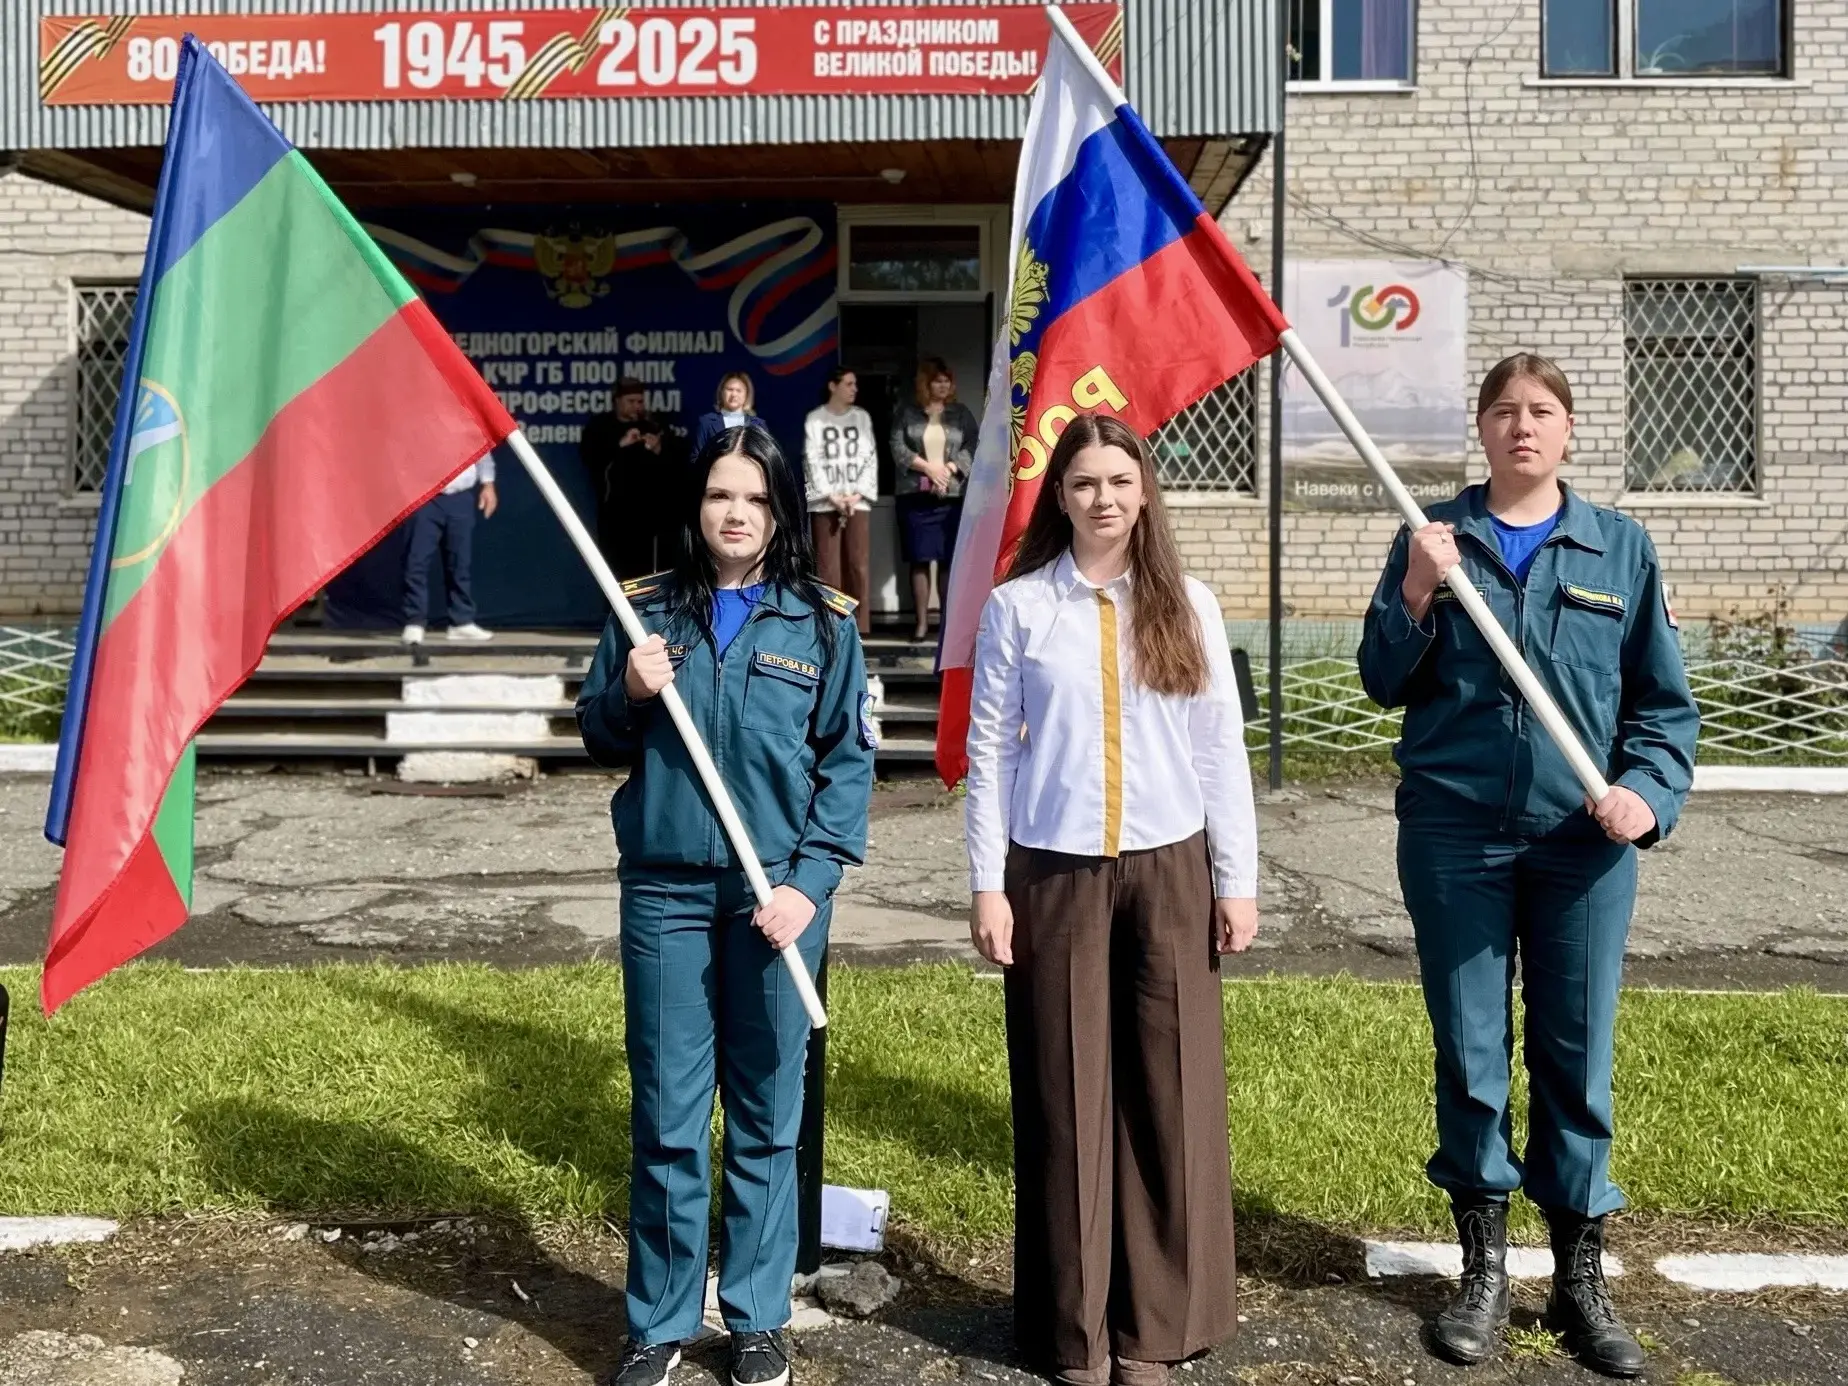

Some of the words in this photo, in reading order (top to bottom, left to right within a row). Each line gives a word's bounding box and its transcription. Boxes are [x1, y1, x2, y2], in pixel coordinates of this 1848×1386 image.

[814, 20, 830, 45] С
[836, 19, 999, 49] ПРАЗДНИКОМ
[127, 36, 178, 82] 80
[201, 38, 326, 80] ОБЕДА!
[373, 20, 526, 90] 1945
[597, 17, 757, 86] 2025
[814, 46, 922, 77] ВЕЛИКОЙ
[928, 48, 1039, 79] ПОБЕДЫ!
[449, 326, 619, 359] ЕДНОГОРСКИЙ
[624, 330, 725, 355] ФИЛИАЛ
[483, 360, 529, 385] КЧР
[535, 361, 565, 385] ГБ
[570, 360, 617, 385] ПОО
[623, 360, 677, 383] МПК
[823, 425, 859, 460] 88
[1294, 480, 1358, 497] Навеки
[1362, 484, 1374, 497] с
[671, 645, 684, 656] ЧС
[759, 653, 800, 671] ПЕТРОВА
